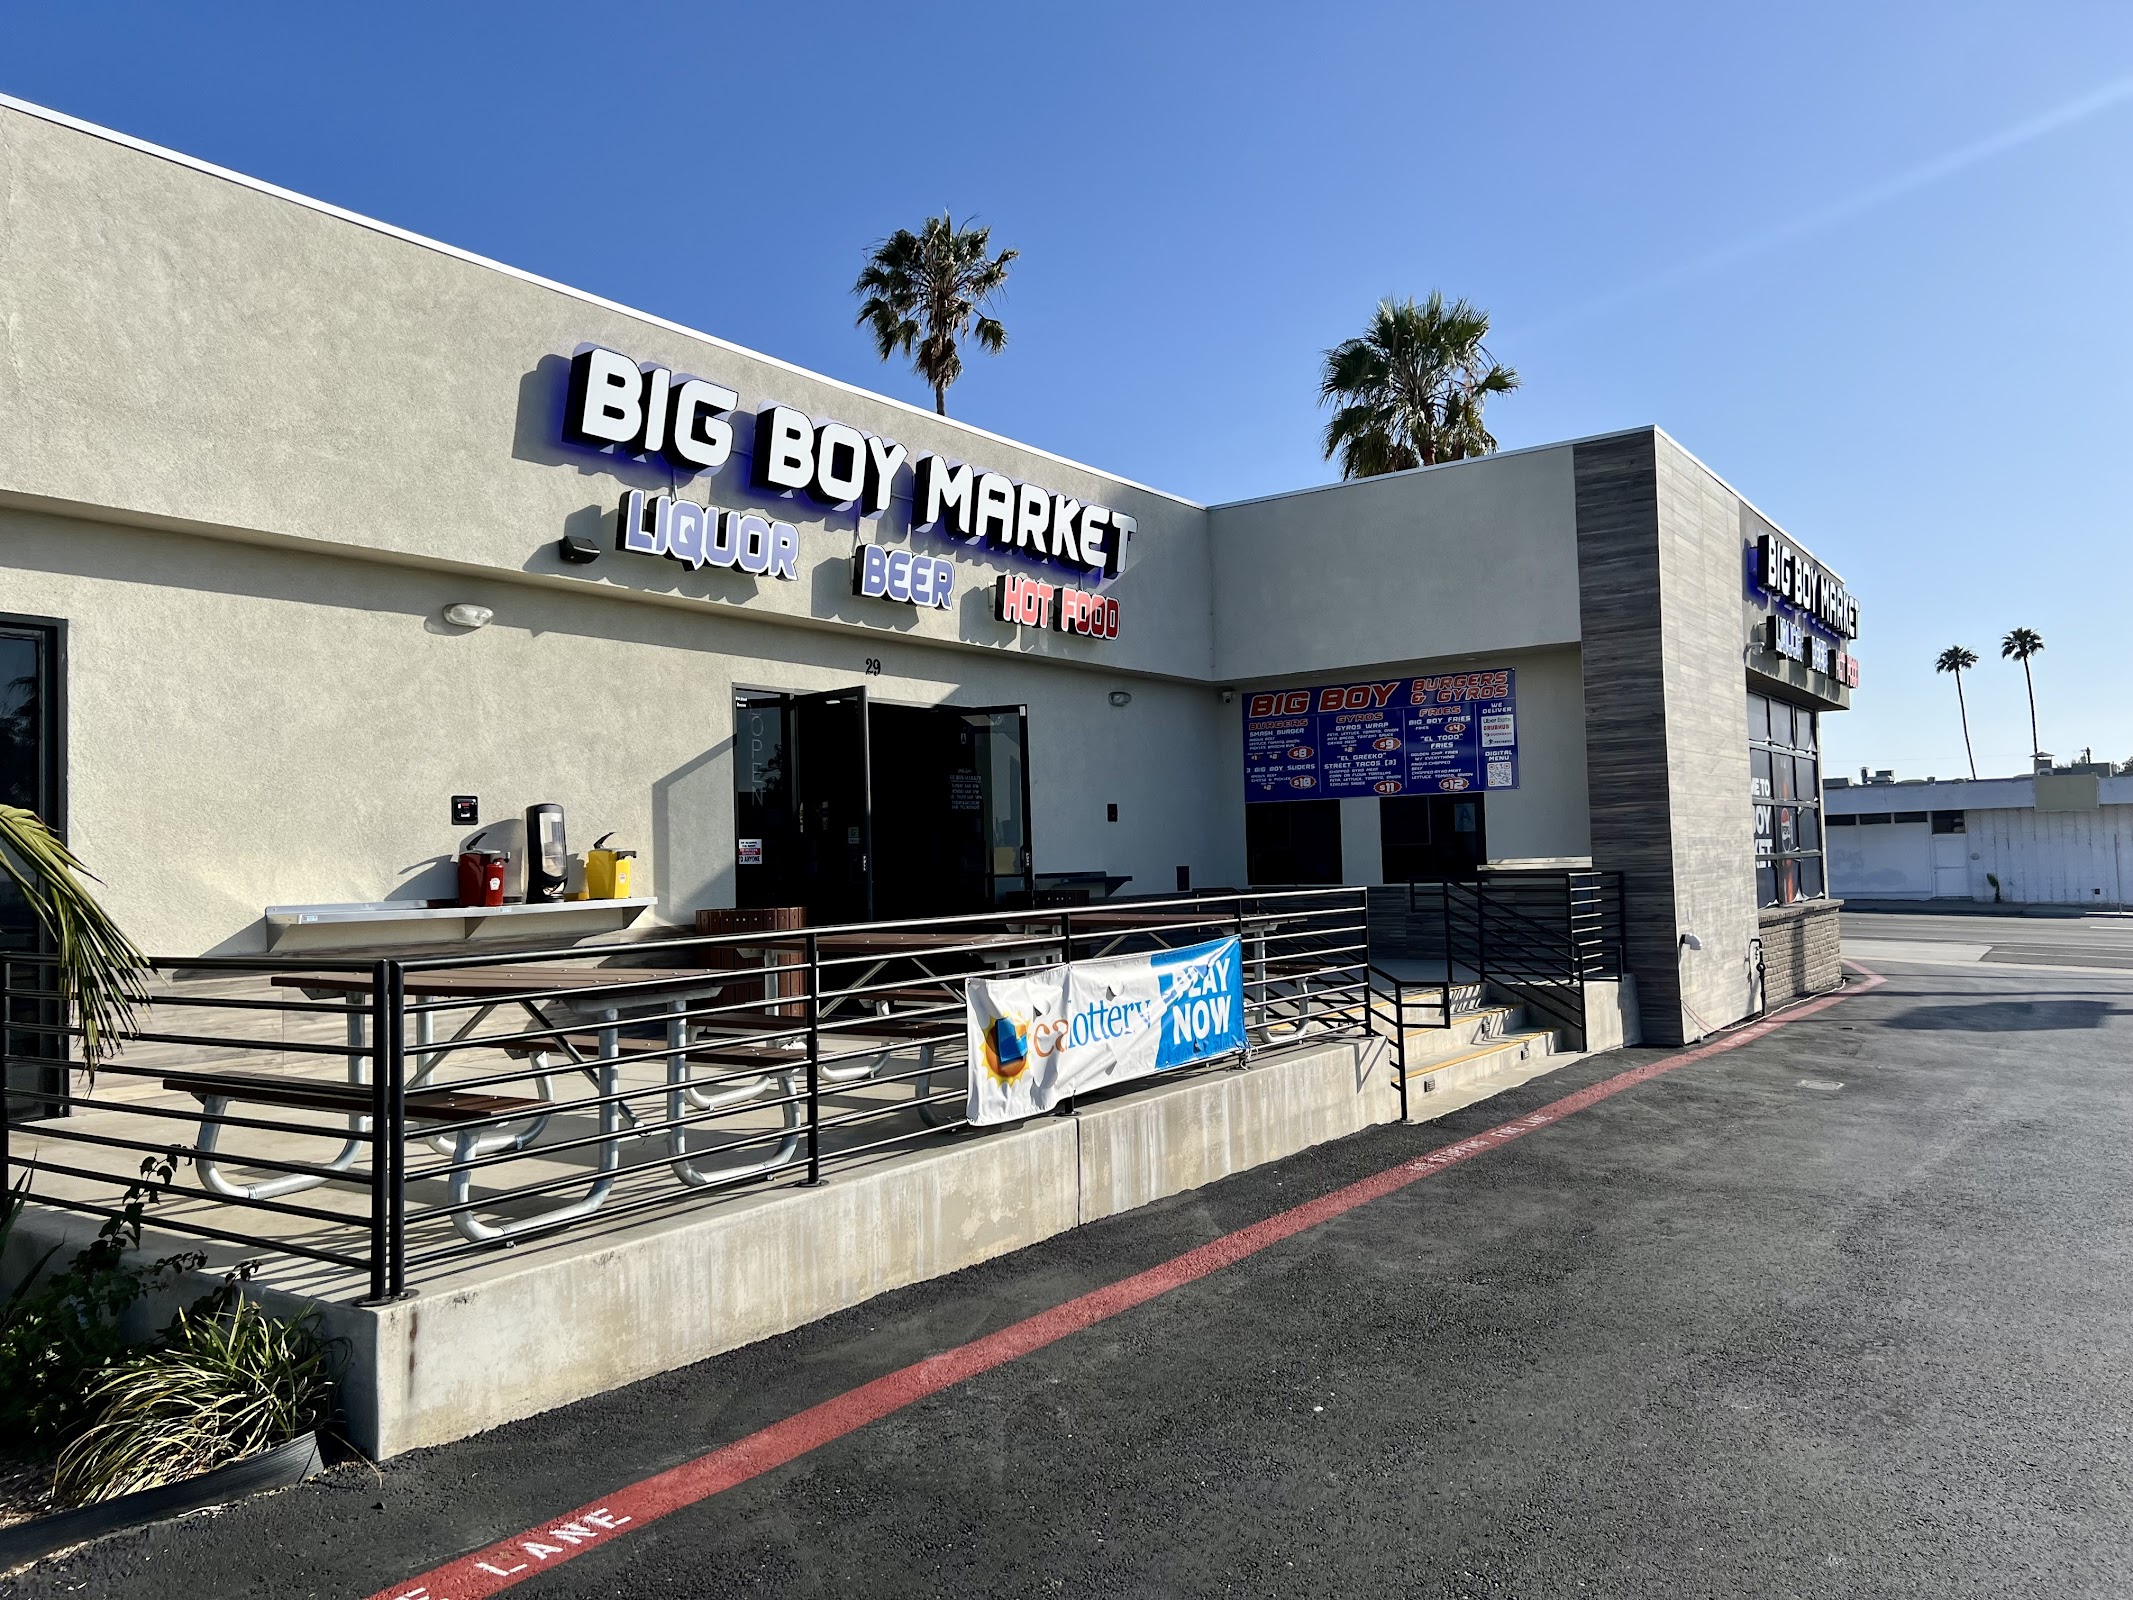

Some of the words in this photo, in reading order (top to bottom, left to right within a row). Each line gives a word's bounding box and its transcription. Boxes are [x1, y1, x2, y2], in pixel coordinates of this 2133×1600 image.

[581, 347, 739, 468] BIG
[768, 405, 910, 512] BOY
[926, 455, 1138, 574] MARKET
[624, 488, 800, 581] LIQUOR
[862, 544, 956, 611] BEER
[1768, 534, 1791, 596] BIG
[1795, 556, 1818, 614] BOY
[1821, 575, 1860, 640] MARKET
[1003, 575, 1054, 628] HOT
[1060, 587, 1121, 641] FOOD
[865, 658, 881, 677] 29
[1411, 670, 1508, 692] BURGERS
[1250, 692, 1310, 718] BIG
[1318, 682, 1400, 712] BOY
[1410, 692, 1426, 705] &
[1437, 684, 1508, 703] GYROS
[1419, 706, 1461, 717] FRIES
[1249, 719, 1308, 731] BURGERS
[1336, 712, 1383, 723] GYROS
[751, 715, 767, 807] OPEN
[1443, 779, 1464, 789] $12
[1761, 778, 1770, 796] TO
[1173, 995, 1231, 1045] NOW
[474, 1507, 632, 1577] LANE
